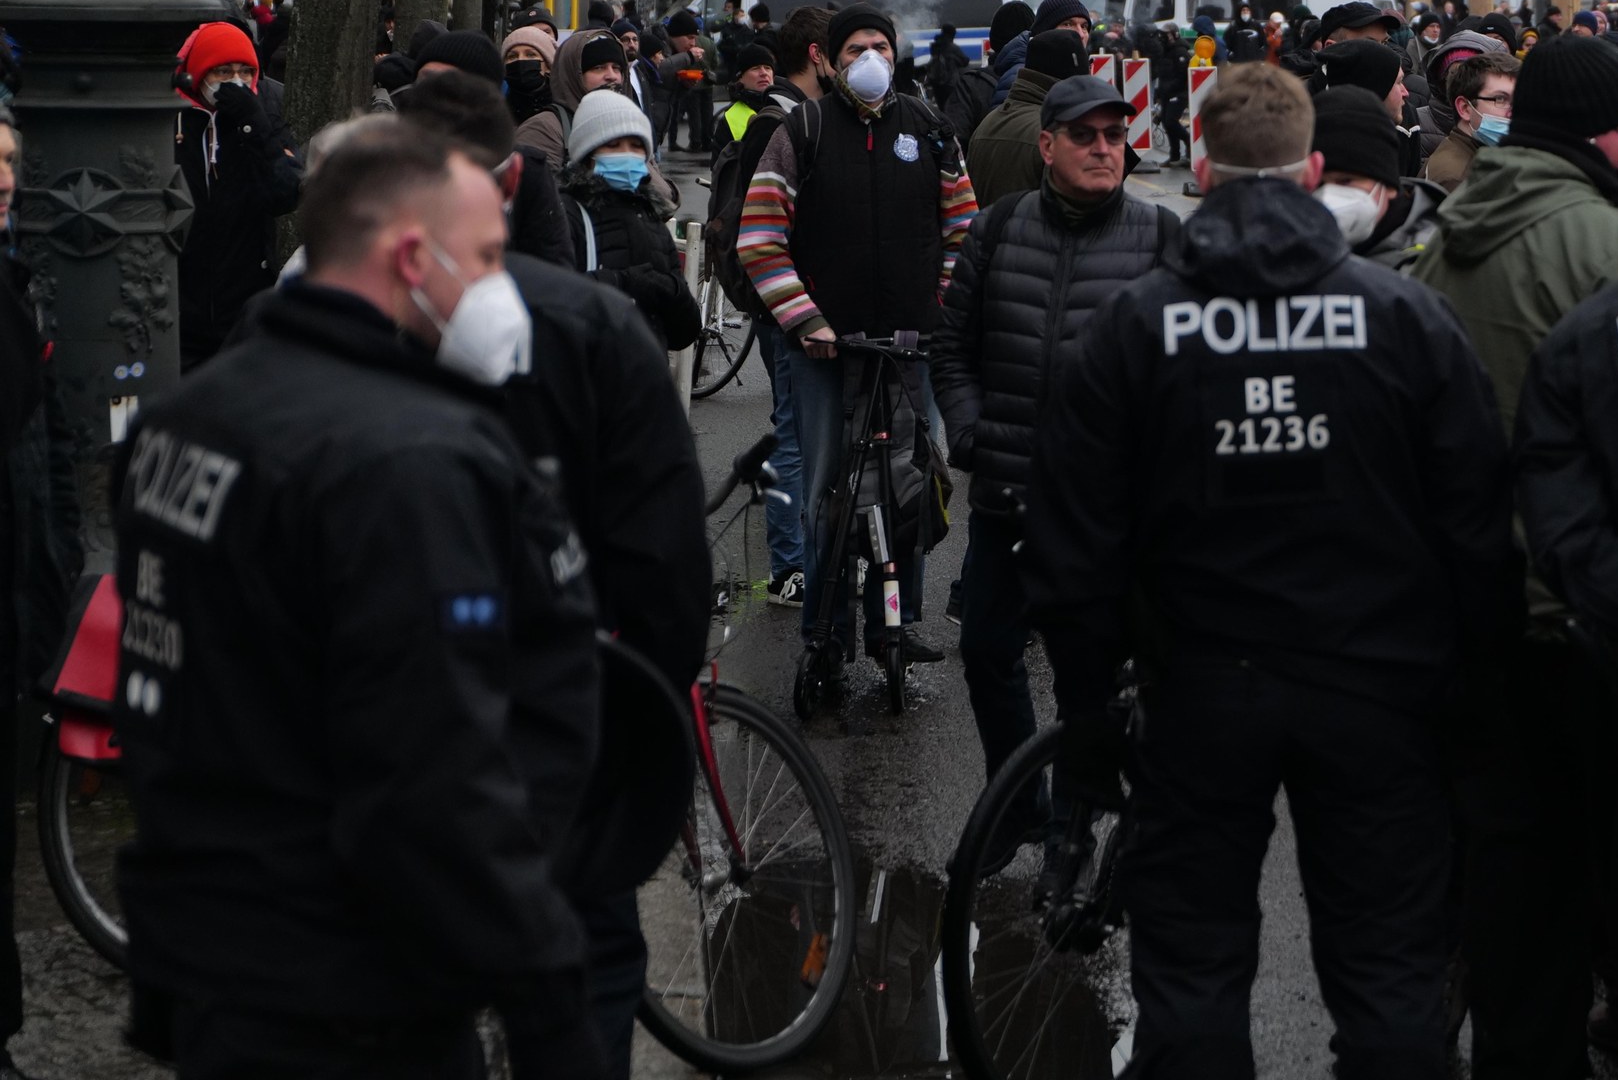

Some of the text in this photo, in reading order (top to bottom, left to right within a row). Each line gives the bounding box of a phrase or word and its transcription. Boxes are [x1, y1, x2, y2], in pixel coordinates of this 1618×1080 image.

[1163, 294, 1367, 355] POLIZEI
[1245, 375, 1297, 414] BE
[1215, 414, 1330, 454] 21236
